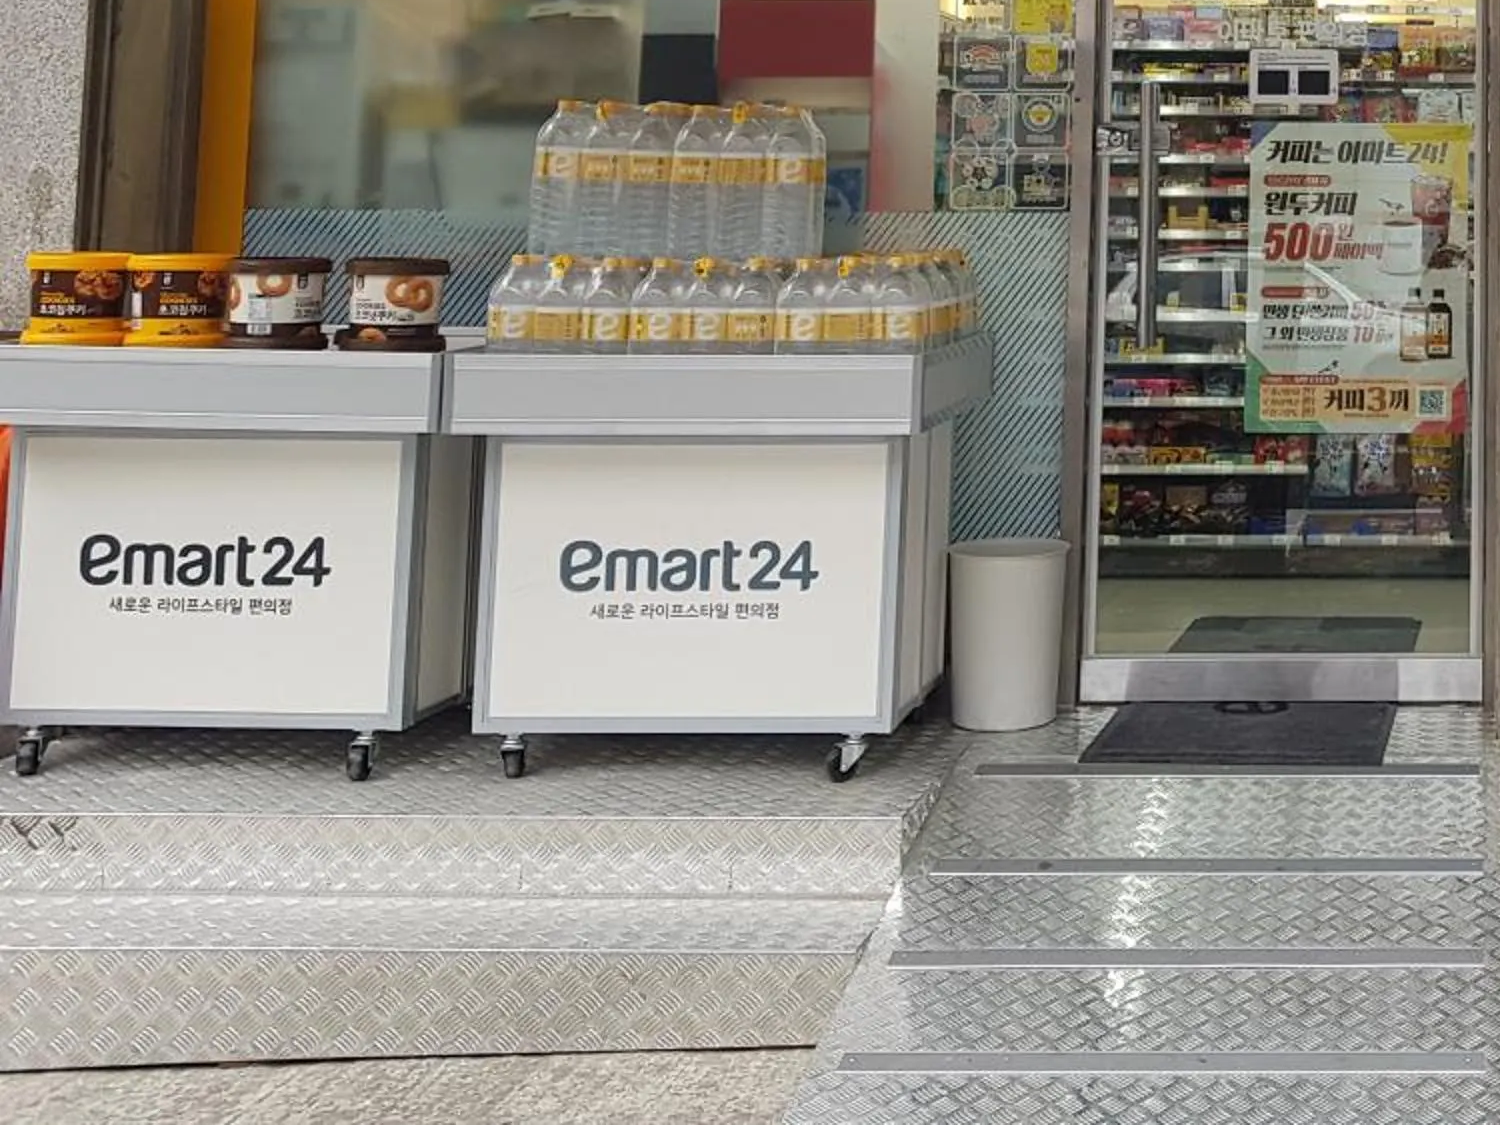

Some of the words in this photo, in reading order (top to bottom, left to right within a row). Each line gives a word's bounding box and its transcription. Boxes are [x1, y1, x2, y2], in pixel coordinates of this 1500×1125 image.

[1264, 191, 1358, 217] 원두커피
[79, 533, 332, 588] emart24
[559, 539, 820, 593] emart24
[109, 596, 153, 614] 새로운
[156, 596, 244, 615] 라이프스타일
[247, 597, 293, 616] 편의점
[589, 602, 635, 620] 새로운
[640, 603, 731, 620] 라이프스타일
[734, 603, 781, 620] 편의점
